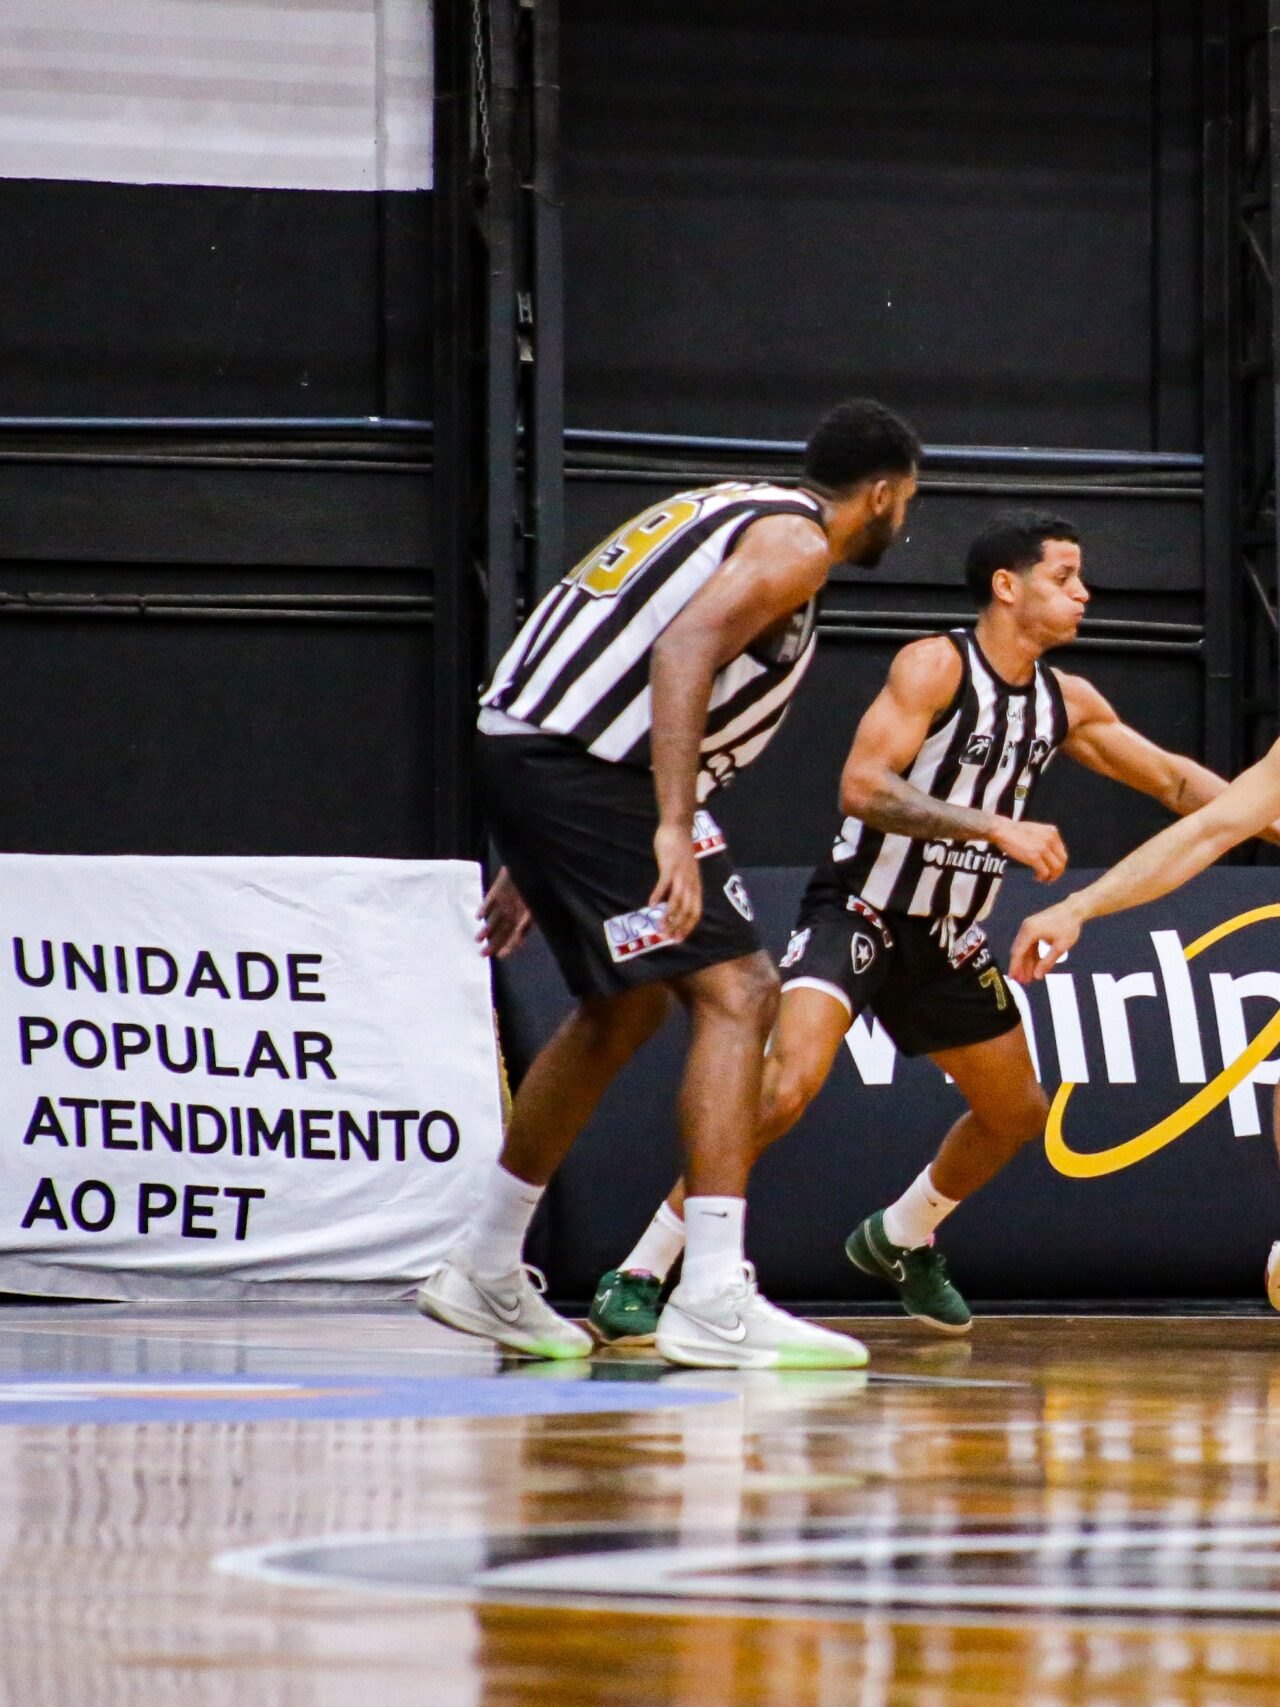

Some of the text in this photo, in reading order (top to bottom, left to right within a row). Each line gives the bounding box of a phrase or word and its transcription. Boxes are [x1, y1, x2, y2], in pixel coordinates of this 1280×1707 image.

[13, 936, 326, 1002] UNIDADE
[19, 1015, 337, 1080] POPULAR
[23, 1096, 460, 1163] ATENDIMENTO
[20, 1177, 266, 1240] AO PET
